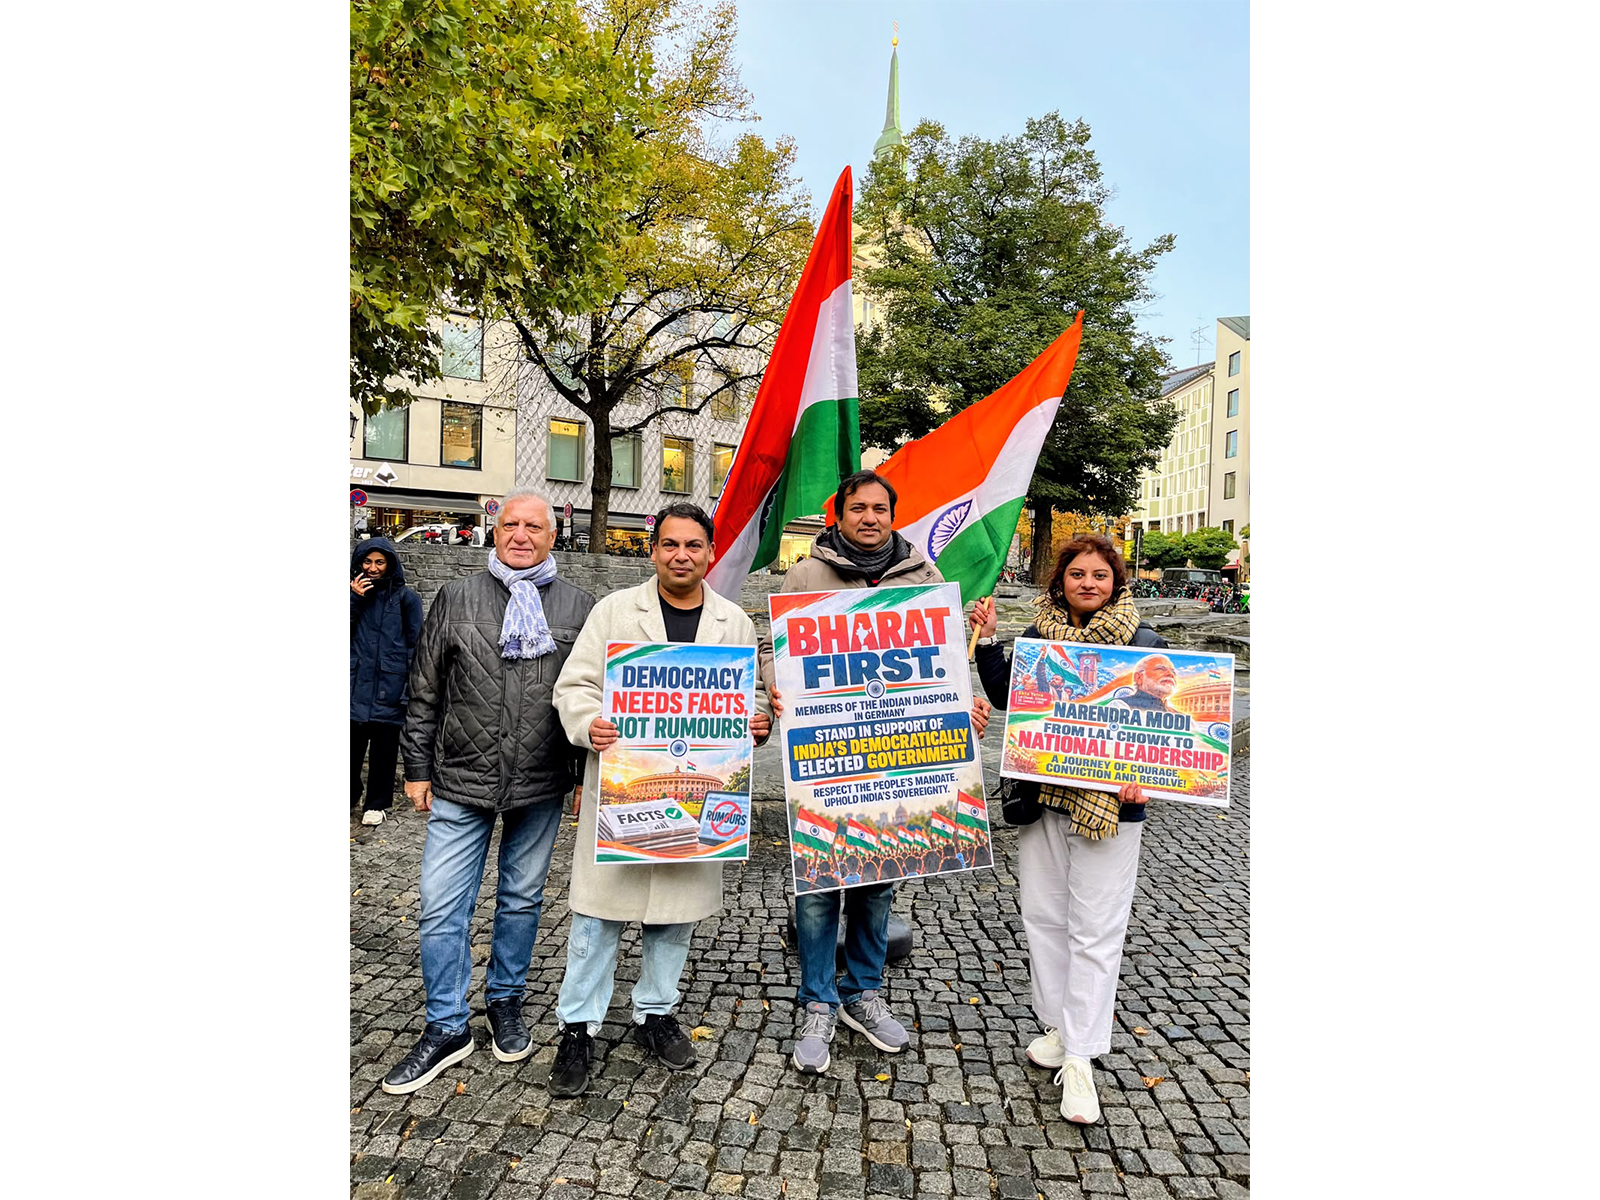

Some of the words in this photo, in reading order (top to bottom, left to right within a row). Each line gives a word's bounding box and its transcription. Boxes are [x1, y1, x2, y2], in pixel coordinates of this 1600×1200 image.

[787, 607, 950, 657] BHARAT
[622, 665, 743, 690] DEMOCRACY
[802, 646, 946, 689] FIRST.
[612, 691, 683, 714] NEEDS
[687, 692, 748, 717] FACTS,
[795, 702, 843, 717] MEMBERS
[845, 701, 858, 712] OF
[859, 699, 877, 710] THE
[879, 696, 912, 708] INDIAN
[913, 692, 959, 706] DIASPORA
[854, 712, 864, 721] IN
[865, 708, 906, 720] GERMANY
[1053, 701, 1142, 727] NARENDRA
[1146, 711, 1191, 731] MODI
[610, 716, 650, 739] NOT
[654, 717, 748, 739] RUMOURS!
[815, 726, 857, 742] STAND
[859, 725, 872, 738] IN
[874, 719, 926, 736] SUPPORT
[929, 718, 944, 730] OF
[1043, 722, 1085, 737] FROM
[1088, 727, 1113, 740] LAL
[1117, 730, 1171, 747] CHOWK
[1174, 736, 1194, 749] TO
[793, 741, 848, 761] INDIA'S
[850, 728, 969, 755] DEMOCRATICALLY
[1018, 730, 1110, 758] NATIONAL
[1114, 741, 1224, 771] LEADERSHIP
[798, 754, 864, 777] ELECTED
[866, 744, 967, 769] GOVERNMENT
[1051, 755, 1059, 763] A
[1062, 756, 1111, 769] JOURNEY
[1114, 762, 1128, 771] OF
[1130, 764, 1180, 778] COURAGE,
[813, 784, 852, 798] RESPECT
[853, 783, 871, 794] THE
[873, 777, 913, 792] PEOPLE'S
[915, 772, 959, 787] MANDATE.
[1046, 763, 1111, 779] CONVICTION
[1114, 772, 1139, 782] AND
[1140, 775, 1187, 788] RESOLVE!
[824, 796, 859, 808] UPHOLD
[860, 792, 891, 804] INDIA'S
[892, 784, 950, 799] SOVEREIGNTY.
[616, 809, 665, 825] FACTS
[705, 810, 747, 826] RUMOURS
